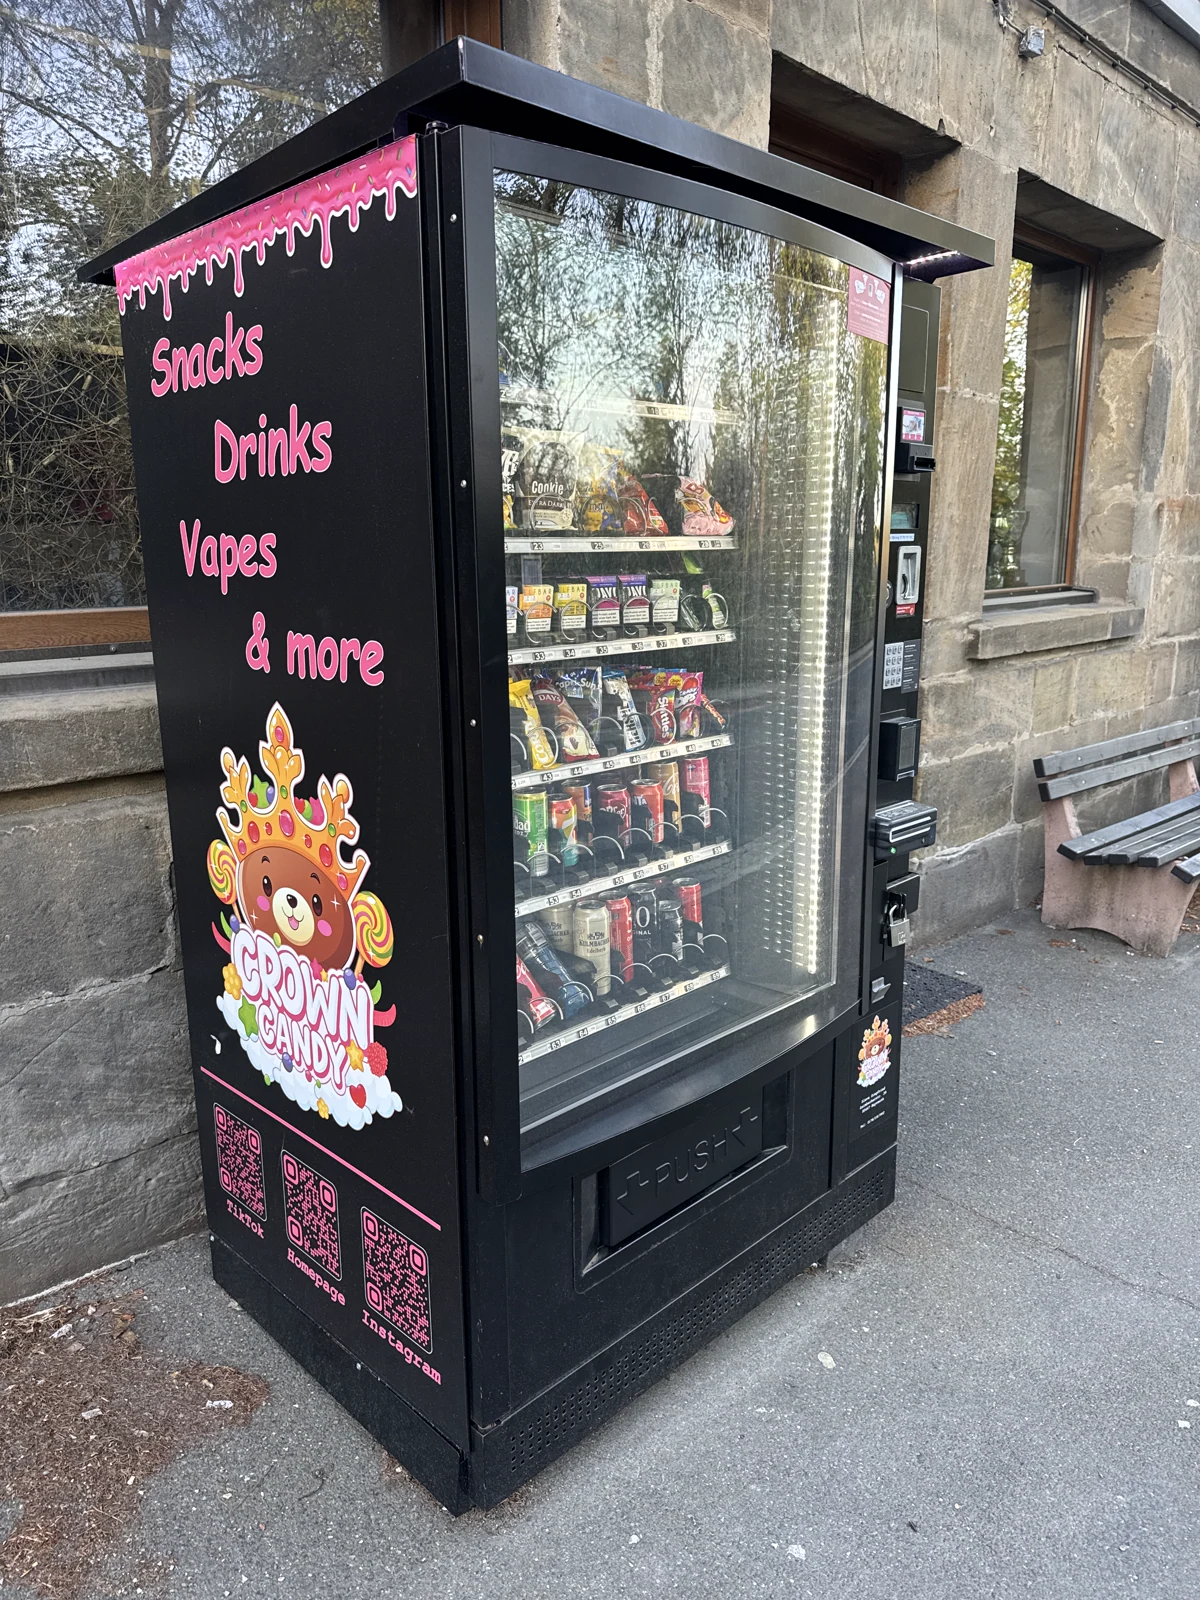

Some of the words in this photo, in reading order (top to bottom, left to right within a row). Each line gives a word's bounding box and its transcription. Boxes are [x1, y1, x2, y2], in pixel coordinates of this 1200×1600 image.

[151, 311, 263, 397] Snacks
[214, 404, 332, 483] Drinks
[532, 480, 564, 494] Cookie
[180, 518, 277, 595] Vapes
[246, 611, 270, 674] &
[286, 630, 384, 686] more
[538, 694, 561, 702] DAYS
[658, 696, 670, 738] Skttles
[549, 896, 559, 904] 53
[571, 890, 581, 898] 54
[234, 928, 369, 1050] CROWN
[258, 1004, 346, 1090] CANDY
[551, 1038, 561, 1049] 63
[579, 1028, 589, 1038] 64
[656, 1128, 727, 1197] PUSH
[226, 1200, 264, 1238] TikTok
[287, 1248, 346, 1305] Homepage
[362, 1310, 441, 1385] Instagram
